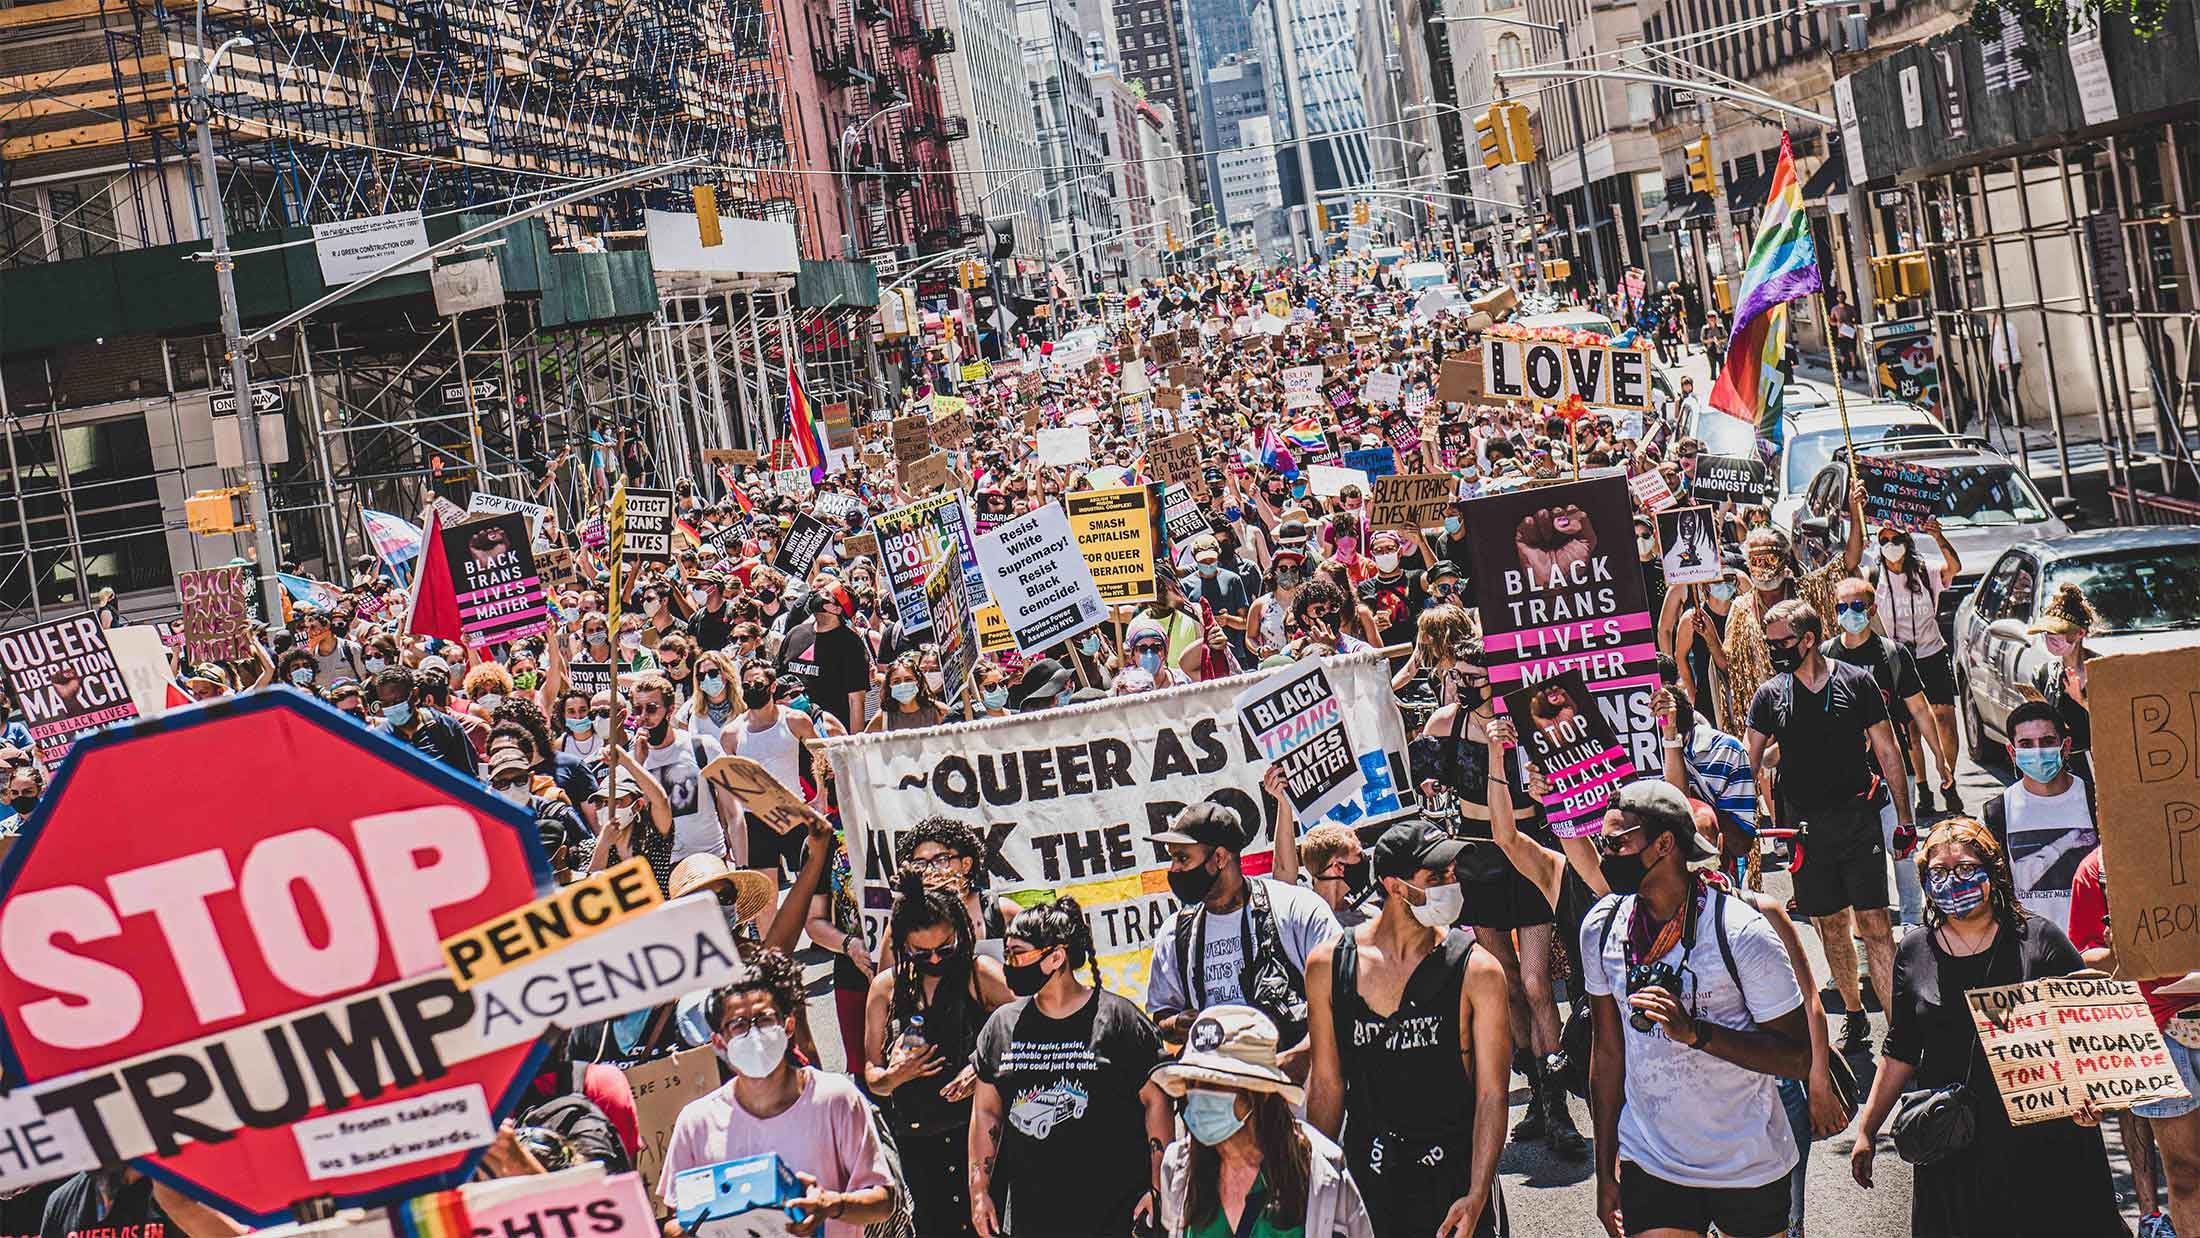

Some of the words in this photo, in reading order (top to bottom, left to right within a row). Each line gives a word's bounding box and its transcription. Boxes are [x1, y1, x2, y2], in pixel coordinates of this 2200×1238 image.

[342, 247, 359, 257] GREEN
[360, 241, 399, 254] CONSTRUCTION
[1888, 323, 1916, 335] TITAN
[1290, 378, 1308, 387] COPS
[1492, 342, 1643, 406] LOVE
[1901, 379, 1914, 389] NY
[1153, 440, 1173, 450] THE
[1444, 434, 1466, 445] STOP
[1154, 445, 1197, 464] FUTURE
[1156, 466, 1165, 476] IS
[1168, 458, 1200, 474] BLACK
[1312, 452, 1339, 462] DISARM
[1172, 470, 1197, 483] NON-
[1695, 478, 1745, 493] AMONGST
[1748, 482, 1765, 495] US
[1710, 466, 1736, 480] LOVE
[1739, 468, 1750, 482] IS
[1883, 469, 1898, 480] NO
[1900, 470, 1926, 484] PRIDE
[475, 496, 502, 508] STOP
[1165, 490, 1188, 508] LACK
[1375, 480, 1410, 504] BLACK
[1414, 478, 1450, 499] TRANS
[1883, 483, 1899, 494] FOR
[1928, 492, 1942, 501] US
[883, 508, 912, 522] PRIDE
[914, 496, 948, 512] MEANS
[1168, 512, 1199, 530] LIVES
[1370, 505, 1406, 525] LIVES
[1407, 502, 1448, 523] MATTER
[624, 516, 662, 531] TRANS
[999, 518, 1040, 545] Resist
[1078, 529, 1140, 544] CAPITALISM
[1089, 518, 1126, 530] SMASH
[1174, 520, 1204, 538] MATTER
[622, 536, 662, 550] LIVES
[785, 530, 802, 553] WHITE
[790, 527, 816, 567] SUPREMACY
[803, 525, 830, 564] EMERGENCY
[885, 524, 941, 554] ABOLISH
[942, 520, 964, 534] THE
[1006, 533, 1044, 556] White
[464, 550, 519, 575] BLACK
[800, 560, 808, 572] AN
[998, 536, 1070, 578] Supremacy!
[1082, 553, 1102, 564] FOR
[1104, 549, 1140, 561] QUEER
[468, 566, 522, 590] TRANS
[1018, 560, 1058, 586] Resist
[1090, 564, 1144, 578] IBERATION
[1504, 556, 1613, 596] BLACK
[181, 569, 244, 602] BLACK
[472, 581, 526, 606] LIVES
[1026, 574, 1061, 598] Black
[475, 597, 529, 620] MATTER
[1019, 581, 1080, 618] Genocide!
[1508, 588, 1617, 627] TRANS
[192, 614, 236, 636] LIVES
[986, 615, 1000, 626] IN
[1022, 617, 1050, 637] Peoples
[1050, 609, 1072, 625] Power
[1027, 624, 1060, 644] Assembly
[1058, 616, 1074, 630] NYC
[1, 618, 106, 672] QUEER
[189, 632, 252, 664] MATTER
[1515, 620, 1622, 660] LIVES
[10, 652, 116, 693] LIBERATION
[572, 672, 595, 681] STOP
[1252, 674, 1328, 730] BLACK
[34, 725, 58, 738] FOR
[60, 715, 96, 732] BLACK
[98, 705, 130, 722] LIVES
[1260, 698, 1340, 760] TRANS
[1533, 714, 1588, 755] STOP
[41, 734, 68, 748] AND
[1150, 718, 1229, 782] AS
[1281, 728, 1343, 778] LIVES
[1544, 739, 1604, 774] KILLING
[1288, 746, 1350, 799] MATTER
[1555, 759, 1616, 794] BLACK
[1563, 778, 1623, 814] PEOPLE
[1031, 823, 1137, 881] THE
[2, 804, 492, 1051] STOP
[446, 868, 656, 983] PENCE
[478, 930, 735, 1037] AGENDA
[1970, 984, 2040, 1012] TONY
[2050, 980, 2139, 999] MCDADE
[1978, 1011, 2048, 1039] TONY
[2057, 1004, 2148, 1025] MCDADE
[1010, 1042, 1026, 1051] Why
[1026, 1042, 1036, 1050] be
[1037, 1042, 1061, 1051] racist,
[1061, 1040, 1085, 1050] sexist,
[1052, 1050, 1095, 1060] transphobic
[1992, 1038, 2057, 1062] TONY
[2068, 1032, 2162, 1055] MCDADE
[0, 1119, 64, 1177] HE
[36, 978, 478, 1173] TRUMP
[1014, 1063, 1028, 1072] you
[1029, 1062, 1050, 1071] could
[1050, 1060, 1064, 1072] just
[1064, 1061, 1076, 1070] be
[1076, 1060, 1099, 1072] quiet.
[2002, 1060, 2062, 1088] TONY
[2075, 1052, 2166, 1076] MCDADE
[2010, 1085, 2070, 1113] TONY
[2086, 1074, 2178, 1100] MCDADE
[340, 1114, 392, 1136] from
[396, 1098, 470, 1132] taking
[320, 1156, 346, 1171] us
[352, 1128, 481, 1167] backwards.
